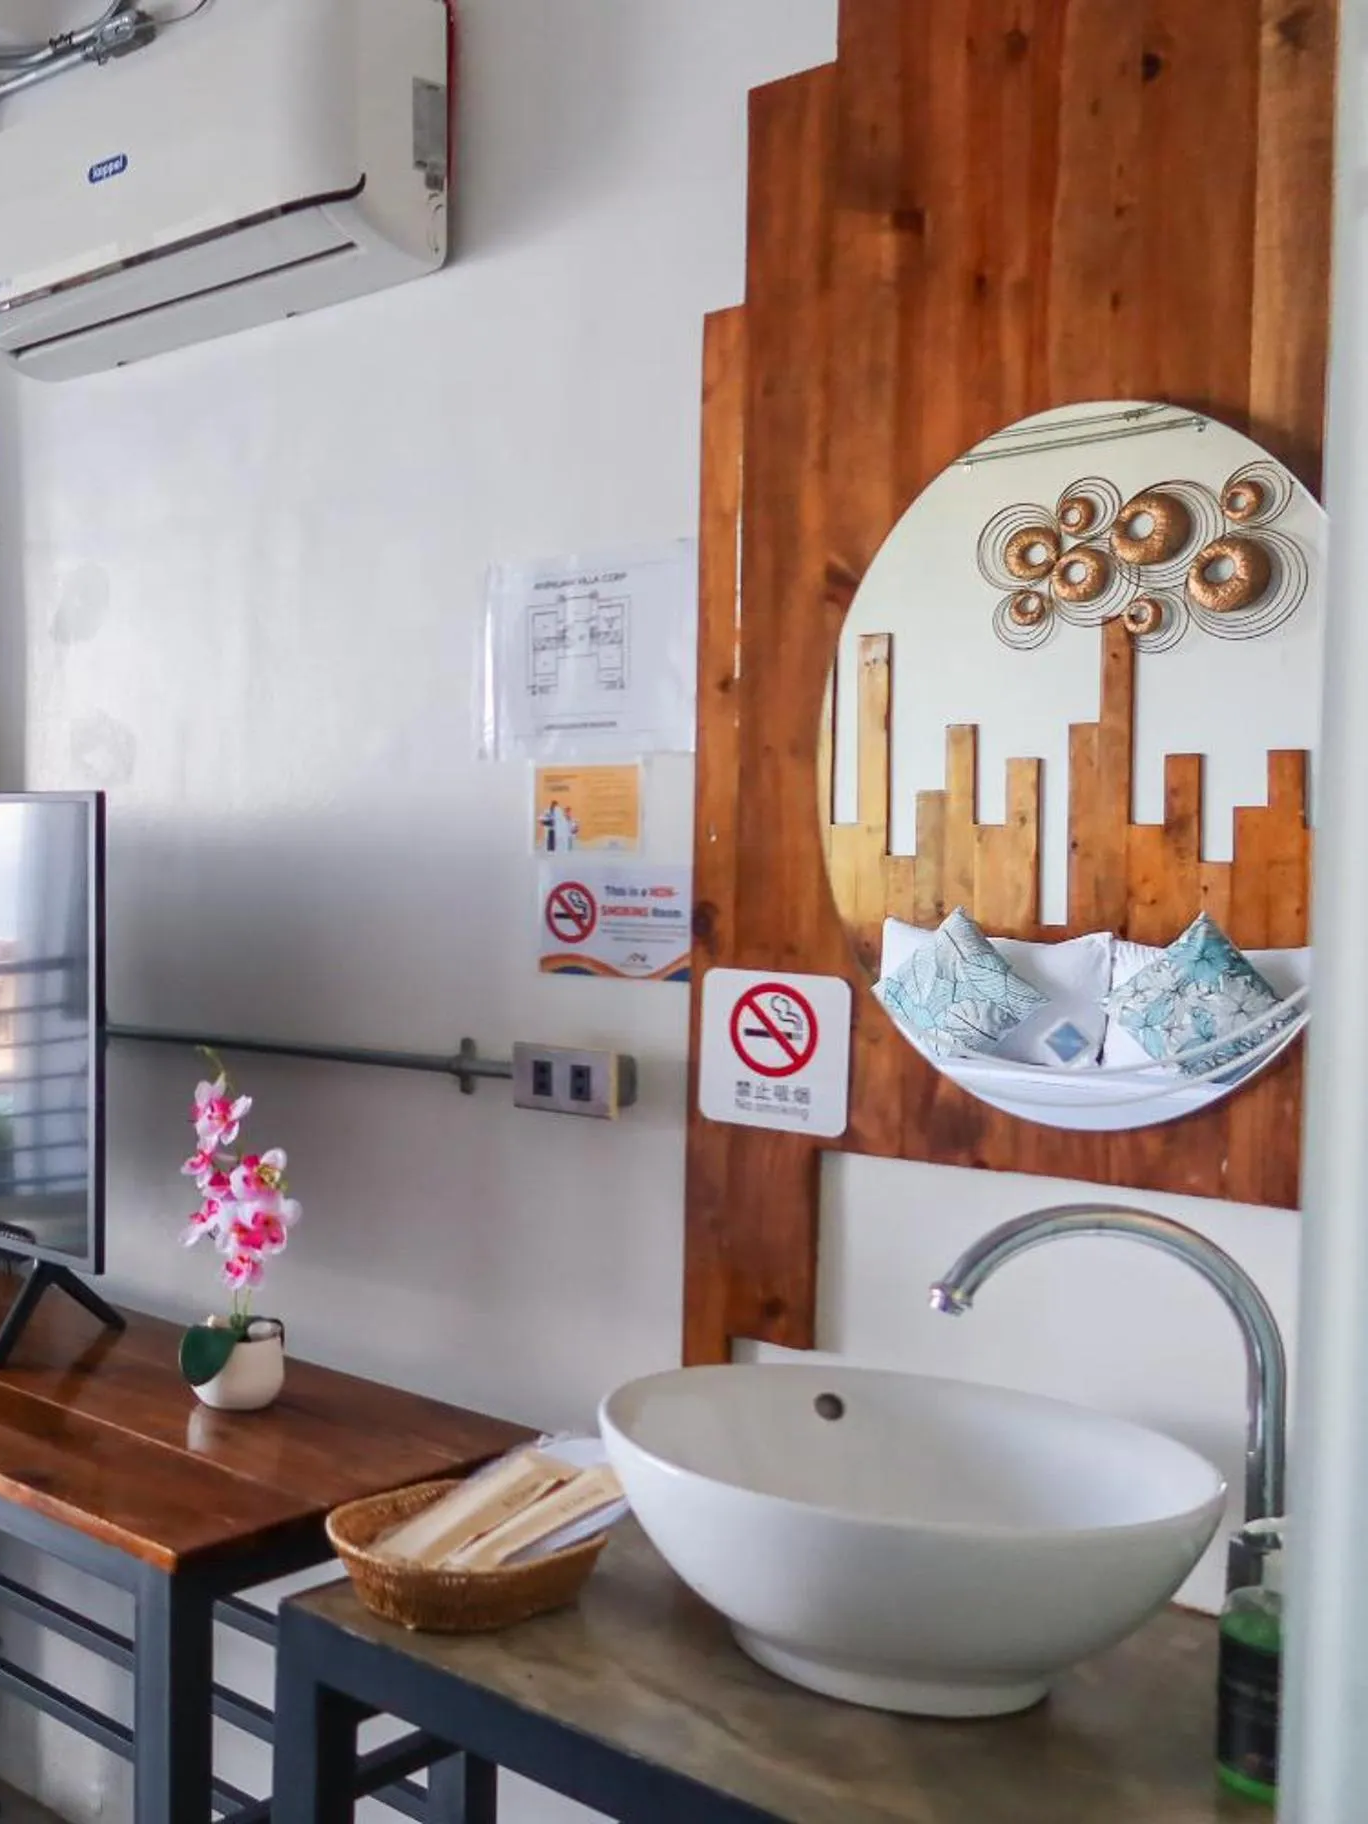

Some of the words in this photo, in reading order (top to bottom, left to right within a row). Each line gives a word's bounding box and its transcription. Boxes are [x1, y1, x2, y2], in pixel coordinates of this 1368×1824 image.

[605, 885, 626, 896] This
[629, 887, 639, 897] is
[601, 905, 649, 917] SMOKING
[734, 1097, 753, 1112] No
[755, 1102, 810, 1121] smoking
